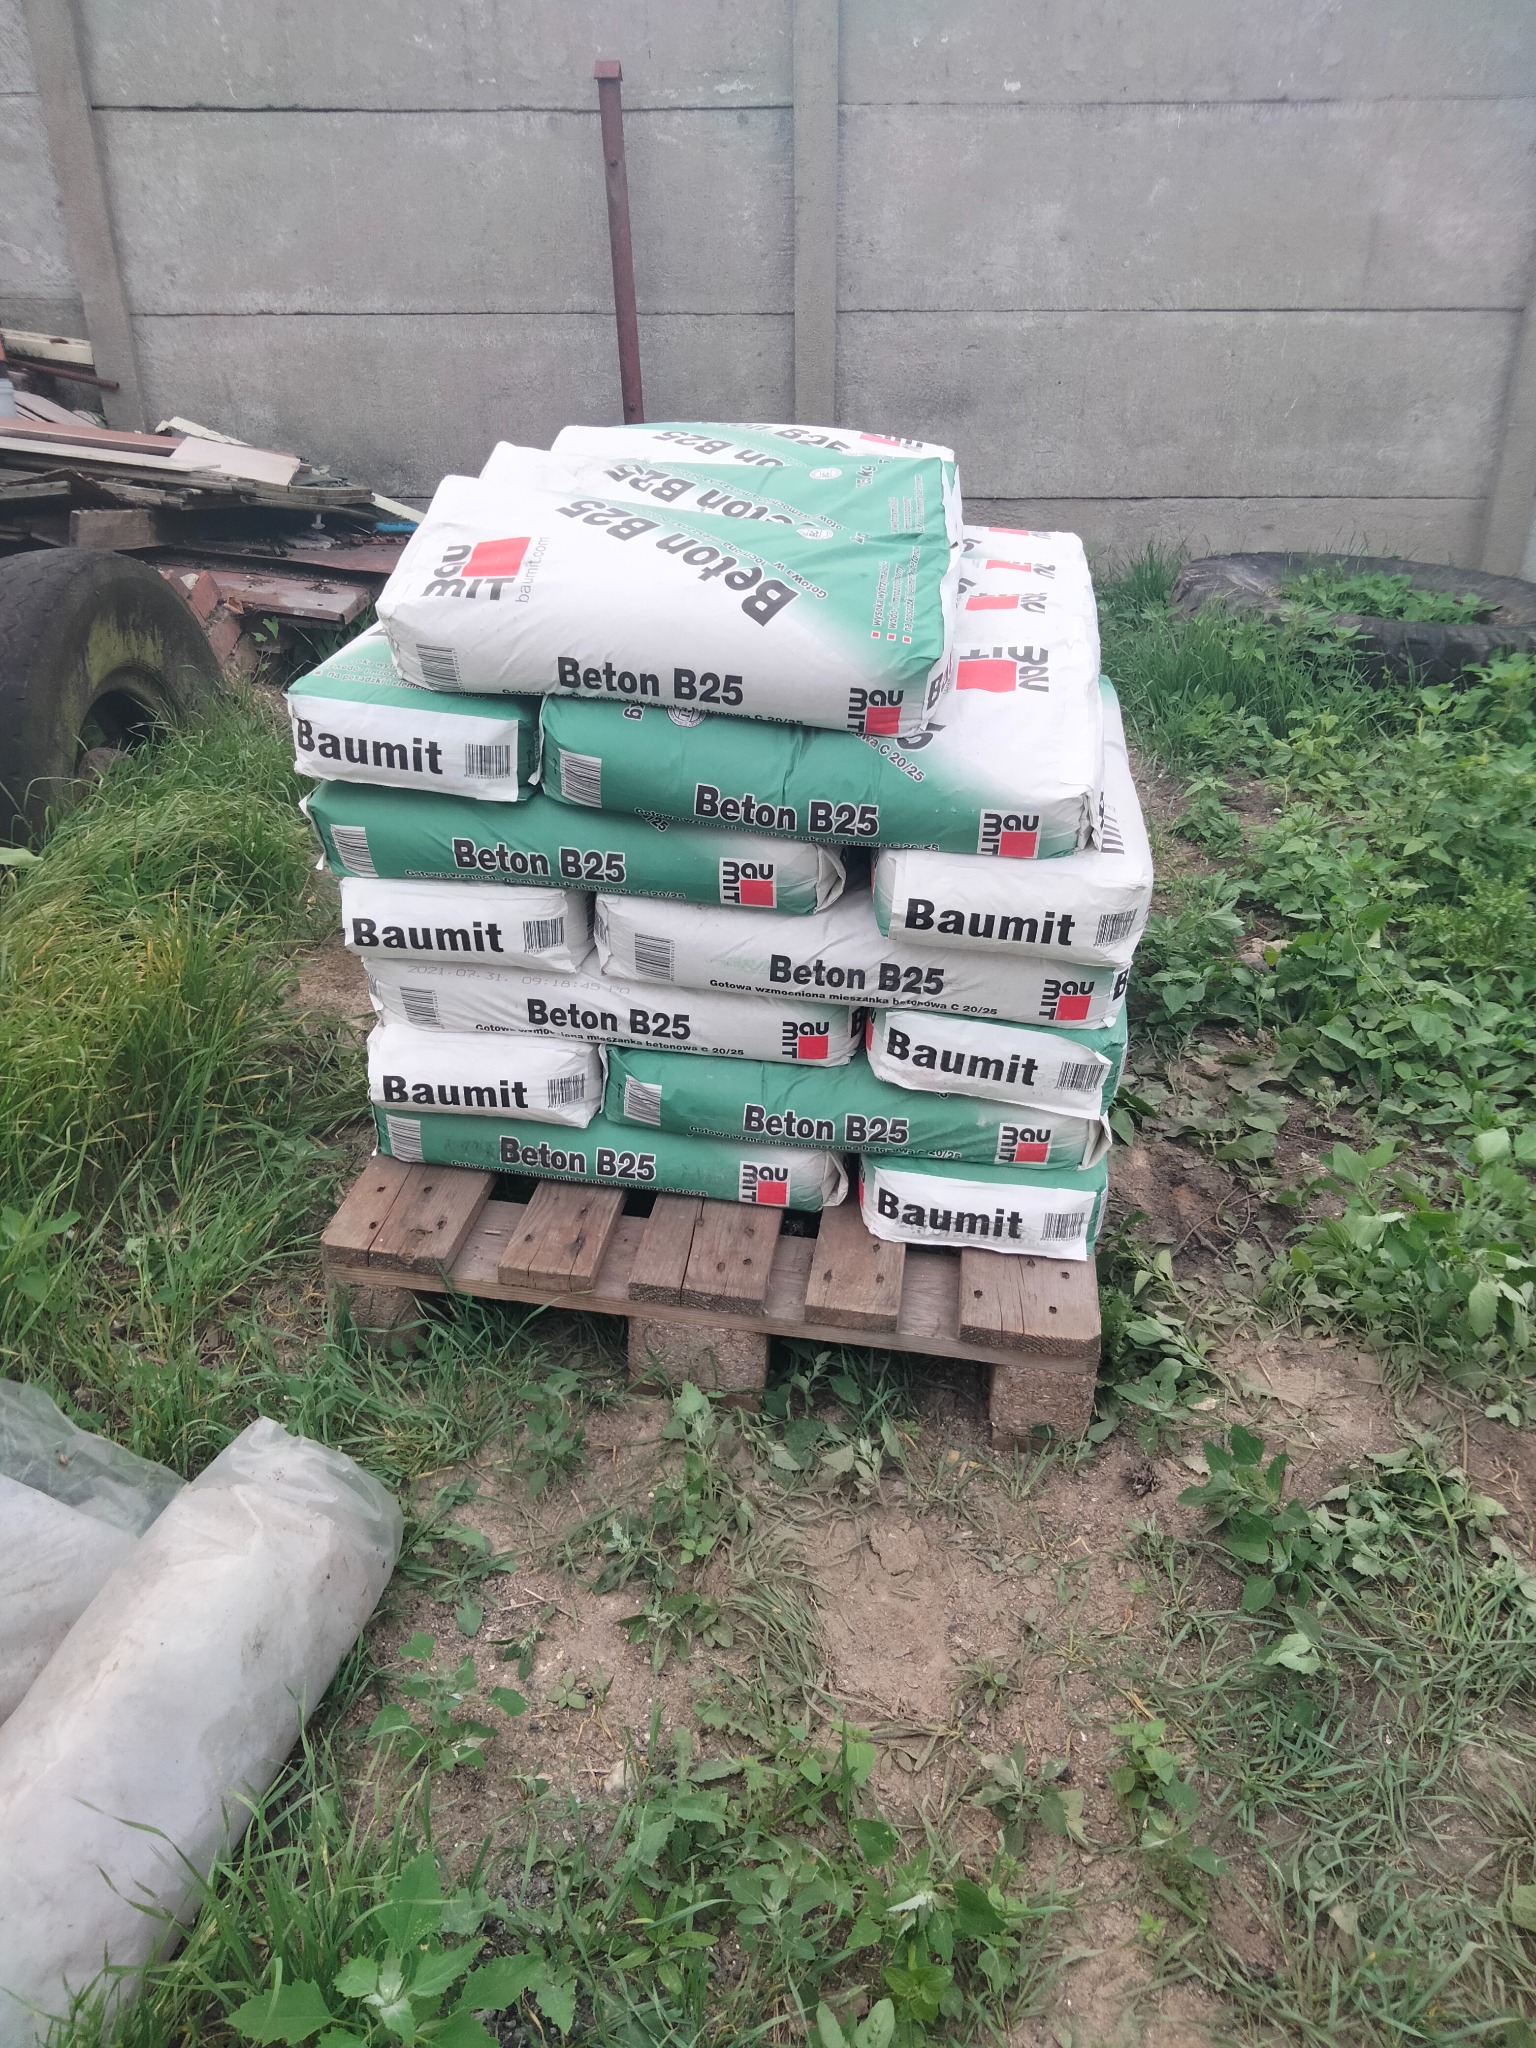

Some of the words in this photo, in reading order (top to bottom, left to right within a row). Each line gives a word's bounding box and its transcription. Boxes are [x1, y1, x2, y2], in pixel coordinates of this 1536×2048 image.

[652, 431, 734, 455] B25
[603, 463, 697, 503] B25
[555, 500, 661, 541] B25
[515, 536, 550, 603] baumit.com
[655, 532, 799, 627] Beton
[558, 656, 660, 698] Beton
[674, 668, 743, 706] B25
[297, 717, 443, 775] Baumit
[880, 744, 891, 755] C
[888, 751, 925, 781] 20/25
[694, 783, 798, 832] Beton
[808, 800, 879, 837] B25
[453, 838, 550, 875] Beton
[560, 848, 626, 883] B25
[352, 918, 504, 953] Baumit
[905, 898, 1075, 946] Baumit
[770, 954, 865, 990] Beton
[878, 963, 944, 996] B25
[709, 979, 752, 991] Gotowa
[755, 986, 826, 999] wzmocniona
[829, 994, 889, 1005] mieszanka
[951, 1003, 960, 1011] C
[962, 1005, 998, 1016] 20/25
[527, 998, 618, 1032] Beton
[630, 1008, 691, 1040] B25
[646, 1040, 698, 1052] betonowa
[712, 1047, 744, 1056] 20/25
[886, 1027, 1038, 1087] Baumit
[383, 1075, 529, 1108] Baumit
[743, 1103, 834, 1140] Beton
[845, 1114, 909, 1144] B25
[500, 1135, 587, 1175] Beton
[597, 1147, 657, 1181] B25
[877, 1187, 1023, 1239] Baumit
